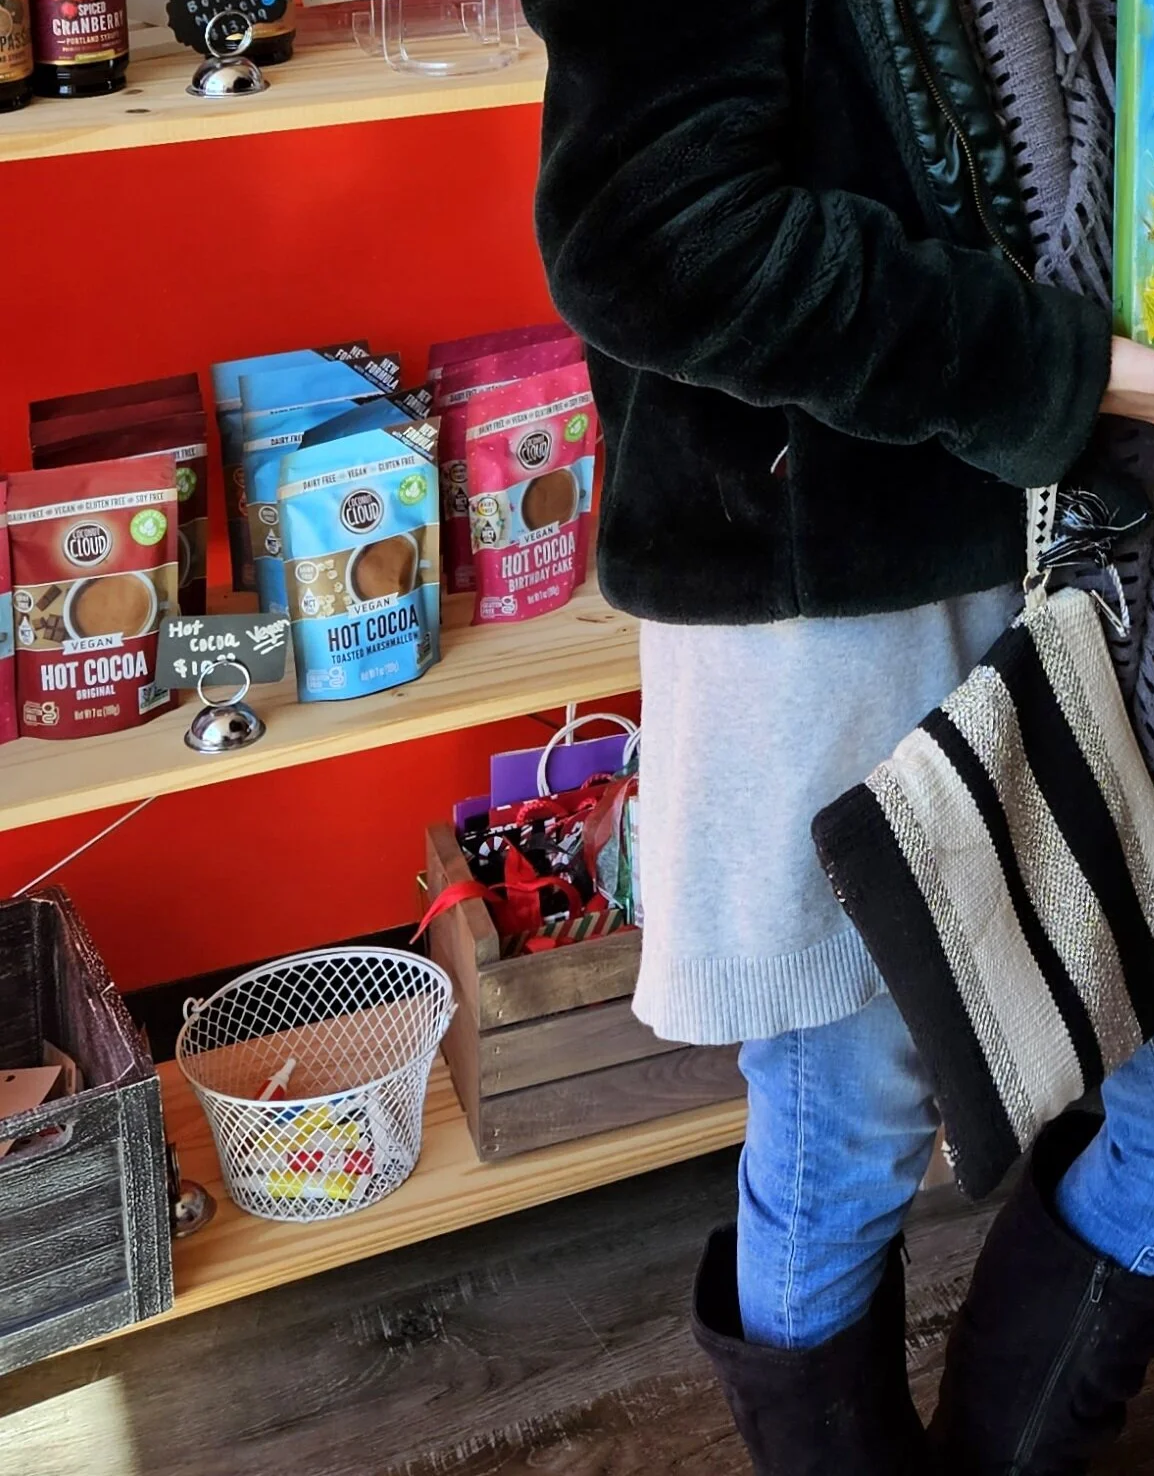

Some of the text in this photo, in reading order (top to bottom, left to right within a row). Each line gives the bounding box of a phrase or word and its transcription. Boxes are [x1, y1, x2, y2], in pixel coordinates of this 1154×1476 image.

[78, 1, 107, 16] SPICED
[52, 10, 124, 36] CRANBERRY
[66, 35, 99, 45] PORTLAND
[364, 361, 400, 390] FORMULA
[380, 357, 400, 374] NEW
[478, 424, 492, 435] DAIRY
[492, 420, 505, 431] FREE
[512, 414, 528, 425] VEGAN
[270, 436, 290, 446] DAIRY
[522, 444, 549, 463] CLOUD
[303, 456, 416, 490] DAIRY FREE VEGAN GLUTEN FREE
[28, 510, 44, 520] FREE
[55, 504, 76, 514] VEGAN
[85, 499, 110, 511] GLUTEN
[110, 497, 125, 507] FREE
[135, 494, 148, 504] SOY
[149, 492, 164, 502] FREE
[349, 495, 373, 507] COCONUT
[346, 505, 380, 526] CLOUD
[72, 526, 100, 539] COCONUT
[524, 526, 554, 542] VEGAN
[68, 535, 106, 557] CLOUD
[502, 531, 576, 578] HOT COCOA
[508, 557, 573, 593] BIRTHDAY CAKE
[354, 599, 391, 614] VEGAN
[169, 619, 204, 638] Hot
[245, 619, 290, 644] Vegan
[328, 604, 420, 652] HOT COCOA
[71, 637, 115, 651] VEGAN
[331, 632, 419, 664] TOASTED MARSHMALLOW
[40, 650, 149, 691] HOT COCOA
[76, 685, 116, 700] ORIGINAL
